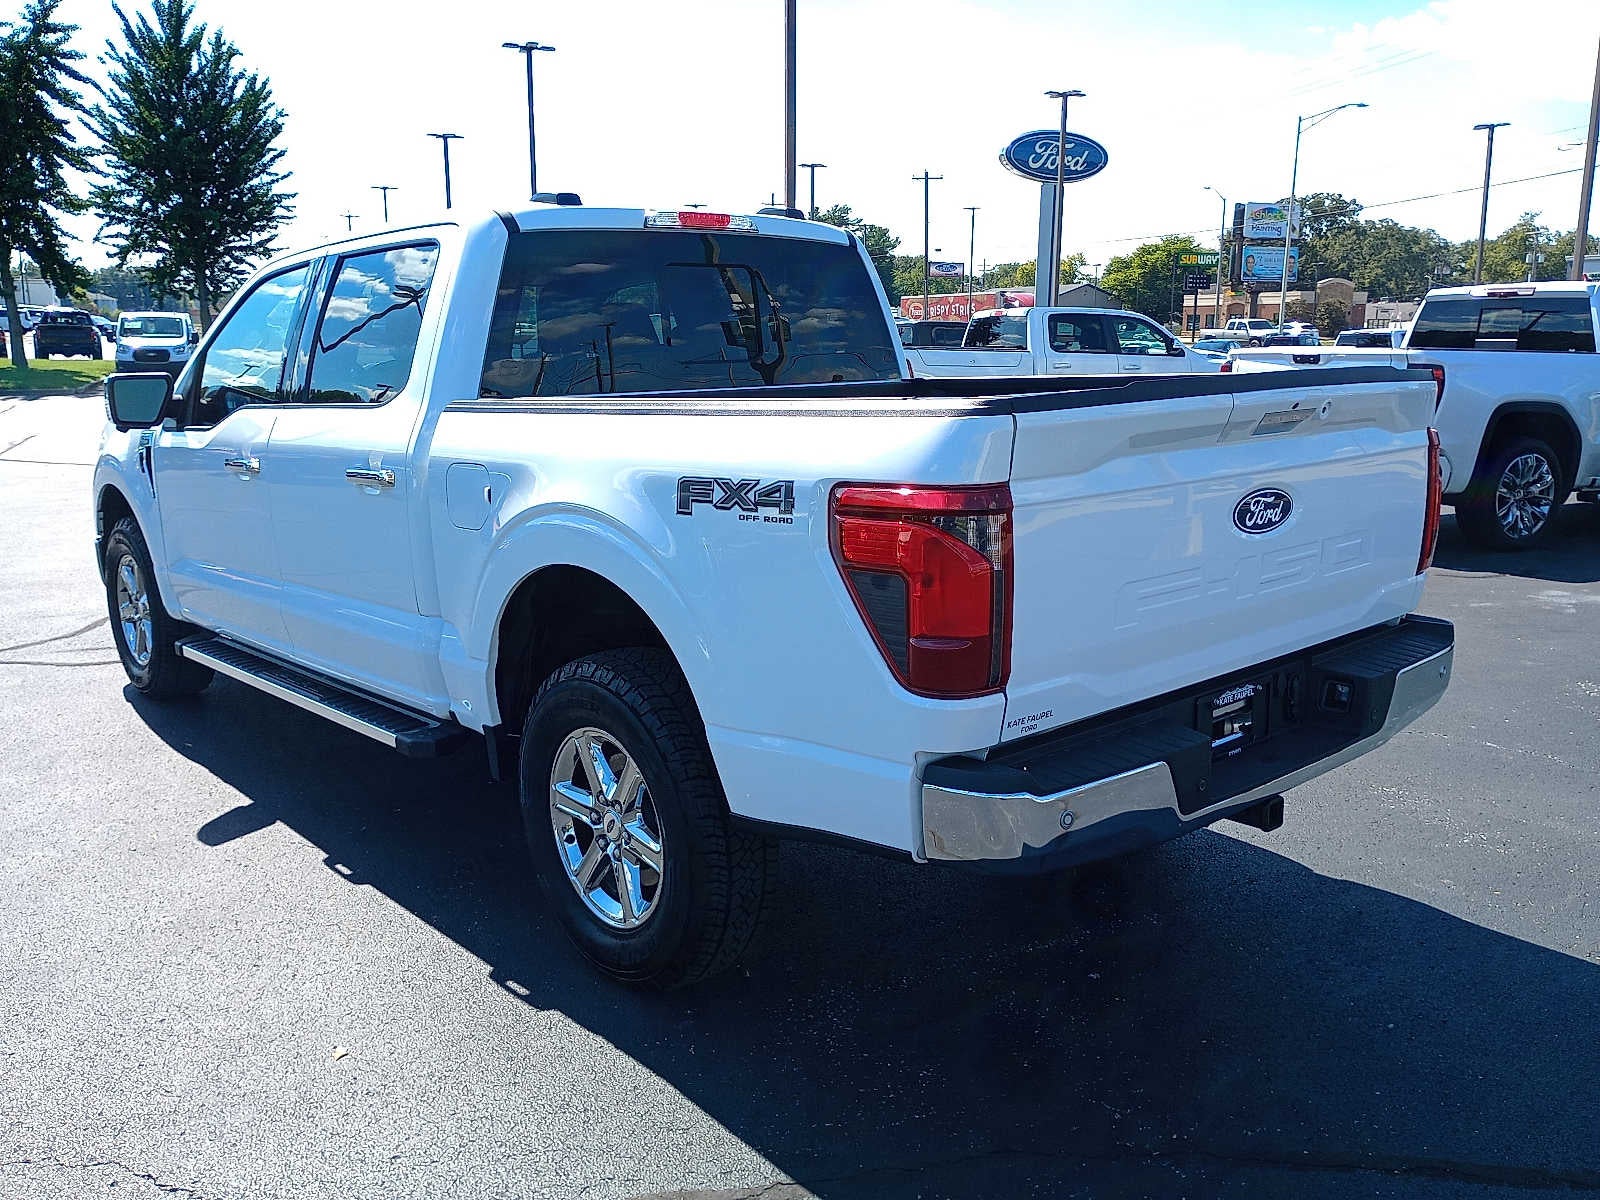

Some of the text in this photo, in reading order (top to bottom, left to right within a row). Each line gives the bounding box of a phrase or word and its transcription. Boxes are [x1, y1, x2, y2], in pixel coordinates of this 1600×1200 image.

[1181, 254, 1218, 265] SUBWAY
[676, 476, 795, 516] FX4
[1245, 496, 1284, 527] Ford
[763, 515, 793, 524] ROAD
[1007, 709, 1054, 729] KATE FAUPEL
[1020, 723, 1038, 734] FORD
